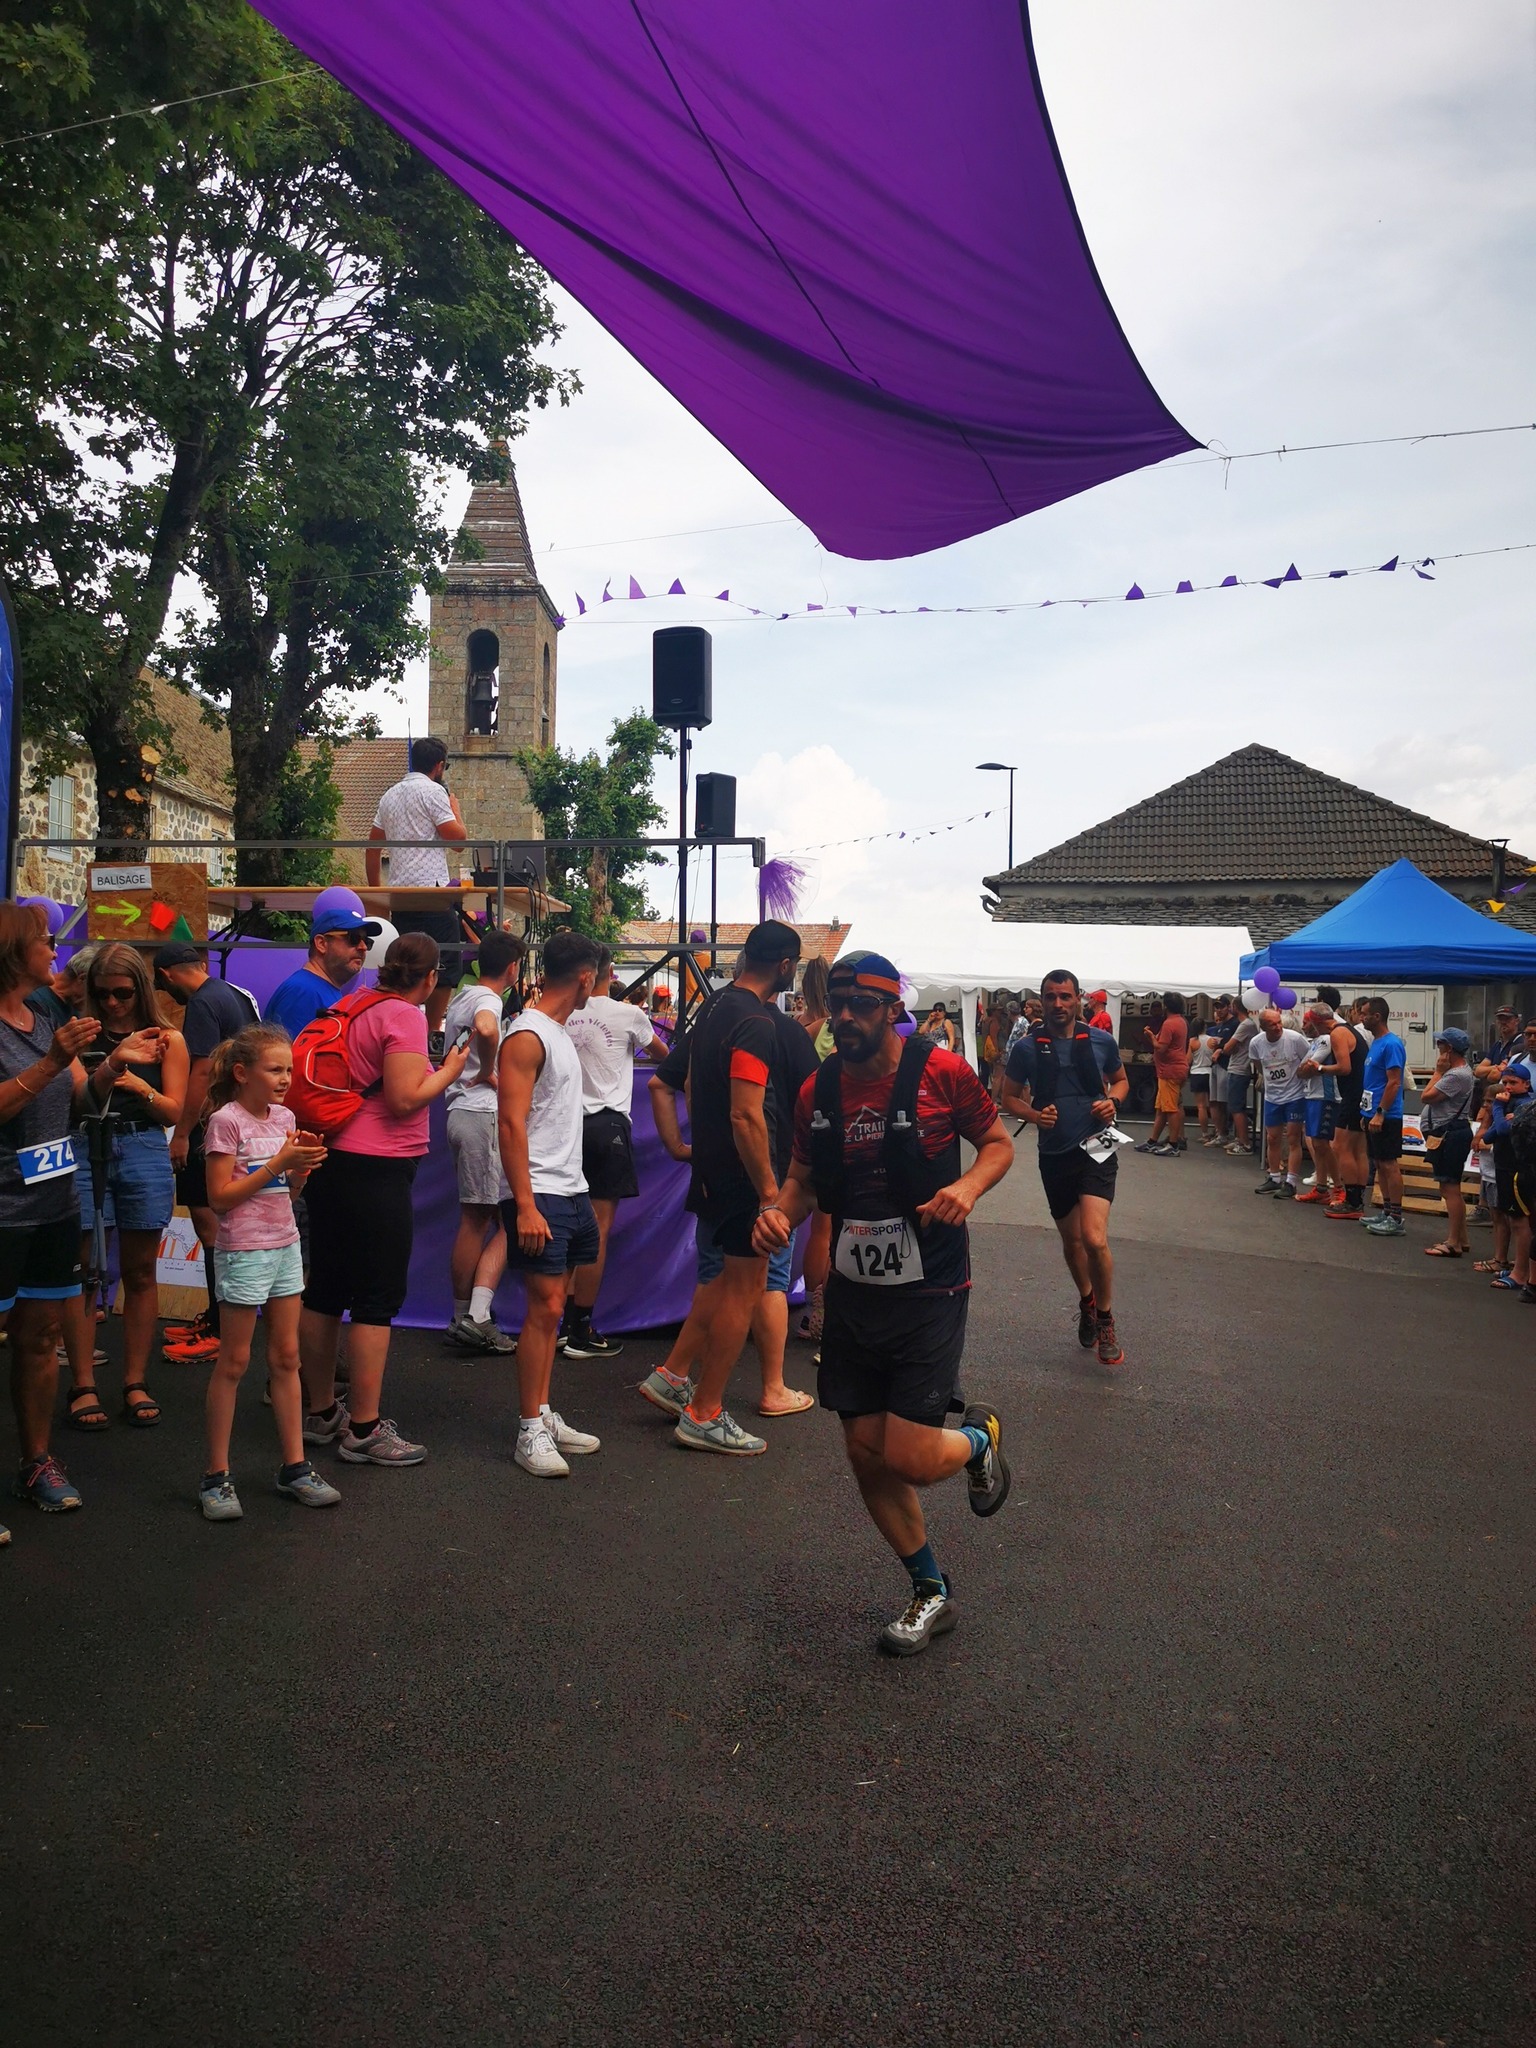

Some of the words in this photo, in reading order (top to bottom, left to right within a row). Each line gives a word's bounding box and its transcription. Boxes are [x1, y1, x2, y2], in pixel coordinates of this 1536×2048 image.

[97, 874, 146, 886] BALISAGE
[1269, 1068, 1287, 1081] 208
[33, 1140, 75, 1173] 274
[850, 1242, 903, 1277] 124
